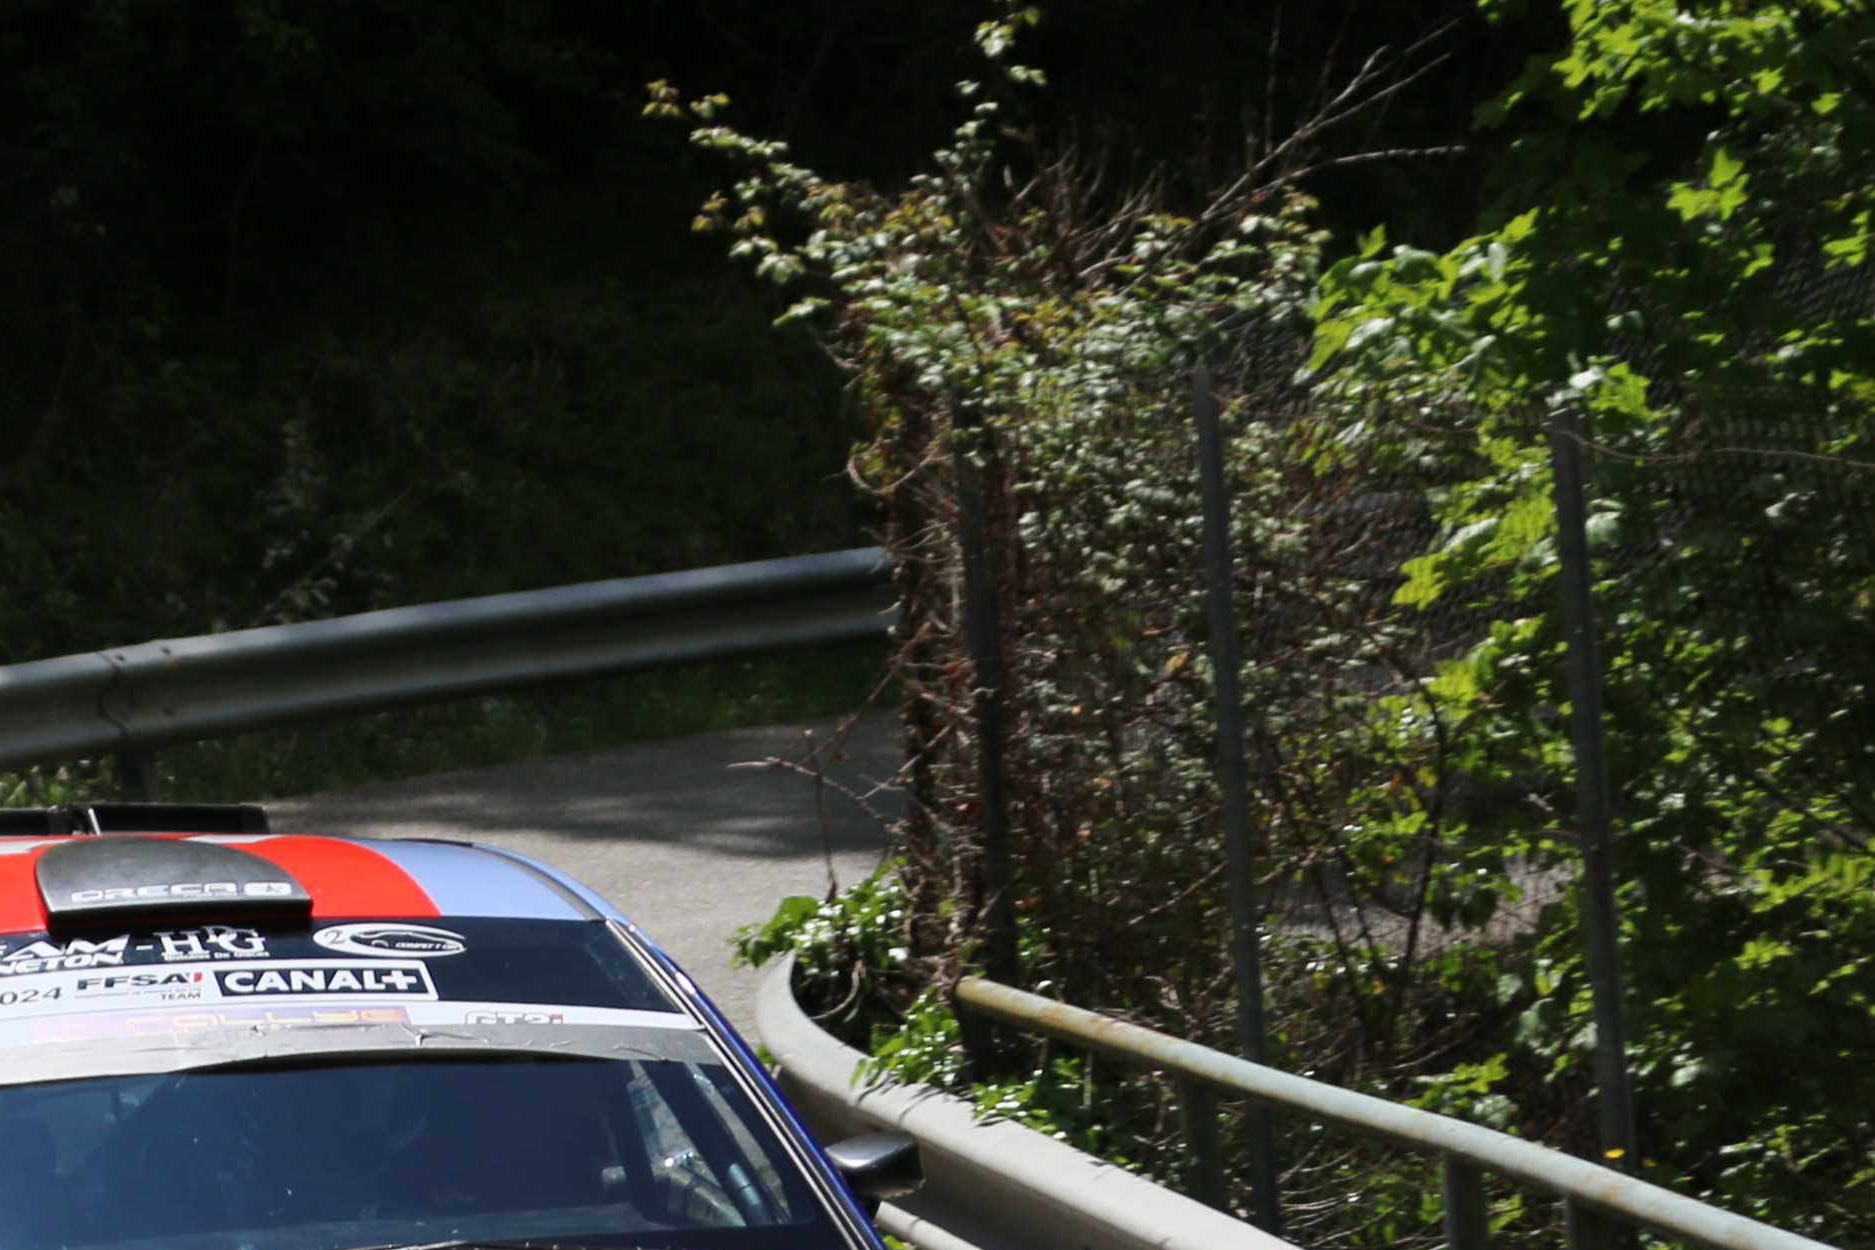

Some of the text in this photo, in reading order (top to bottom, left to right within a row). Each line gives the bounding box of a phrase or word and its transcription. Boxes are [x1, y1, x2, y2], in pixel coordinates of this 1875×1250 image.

[76, 972, 191, 990] FFSA
[224, 969, 418, 992] CANAL+
[160, 992, 202, 1000] TEAM
